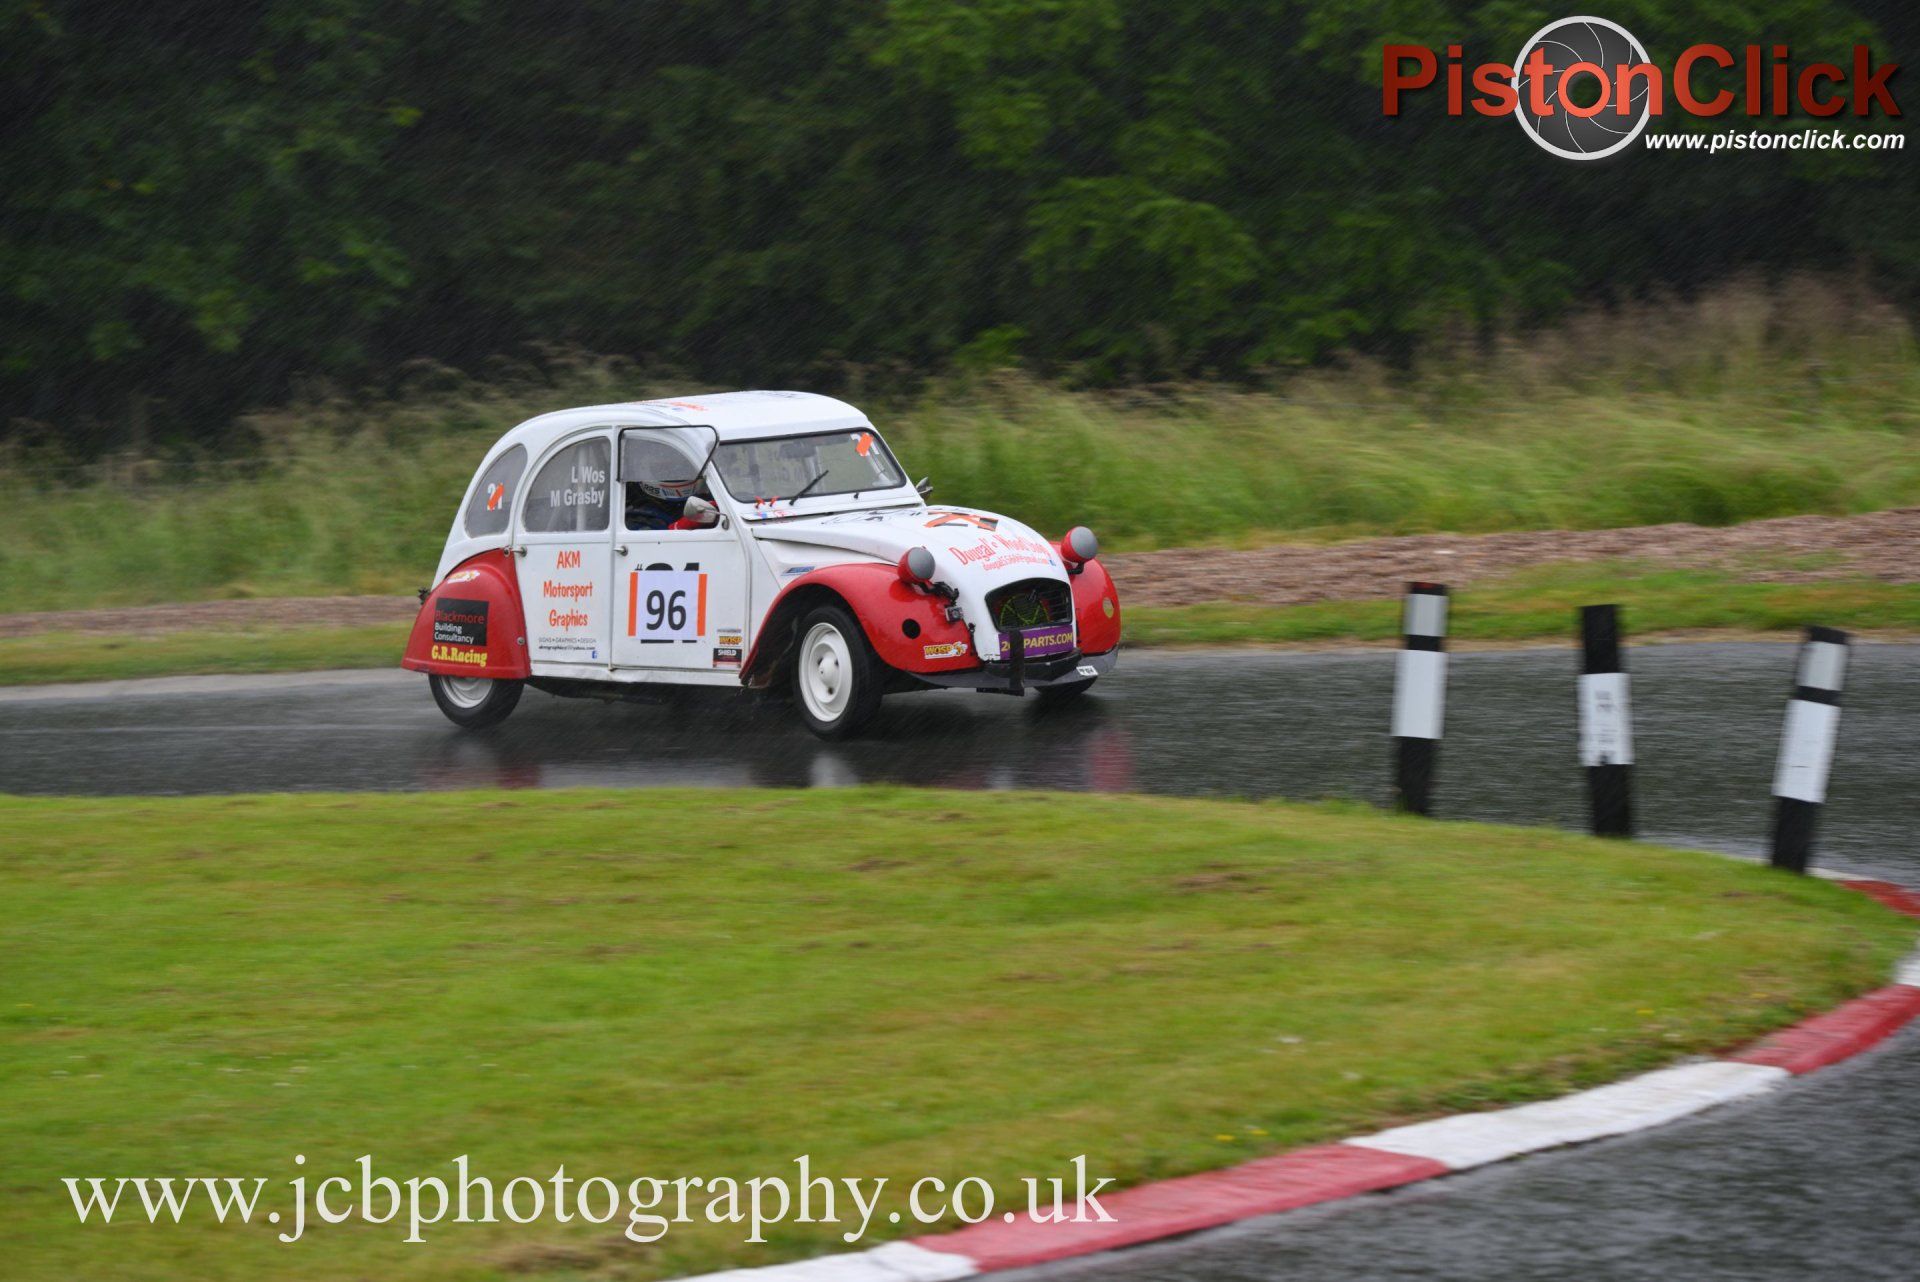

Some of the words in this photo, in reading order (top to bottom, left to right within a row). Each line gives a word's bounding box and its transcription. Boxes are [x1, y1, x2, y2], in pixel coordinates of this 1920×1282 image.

[571, 466, 578, 483] L
[582, 466, 605, 483] Wos
[550, 490, 560, 507] M
[563, 488, 605, 508] Grasby
[557, 550, 581, 569] AKM
[543, 580, 593, 602] Motorsport
[434, 610, 485, 624] Blackmore
[646, 590, 687, 631] 96
[435, 622, 462, 634] Building
[548, 608, 588, 632] Graphics
[434, 632, 475, 645] Consultancy
[925, 645, 953, 656] WOSP
